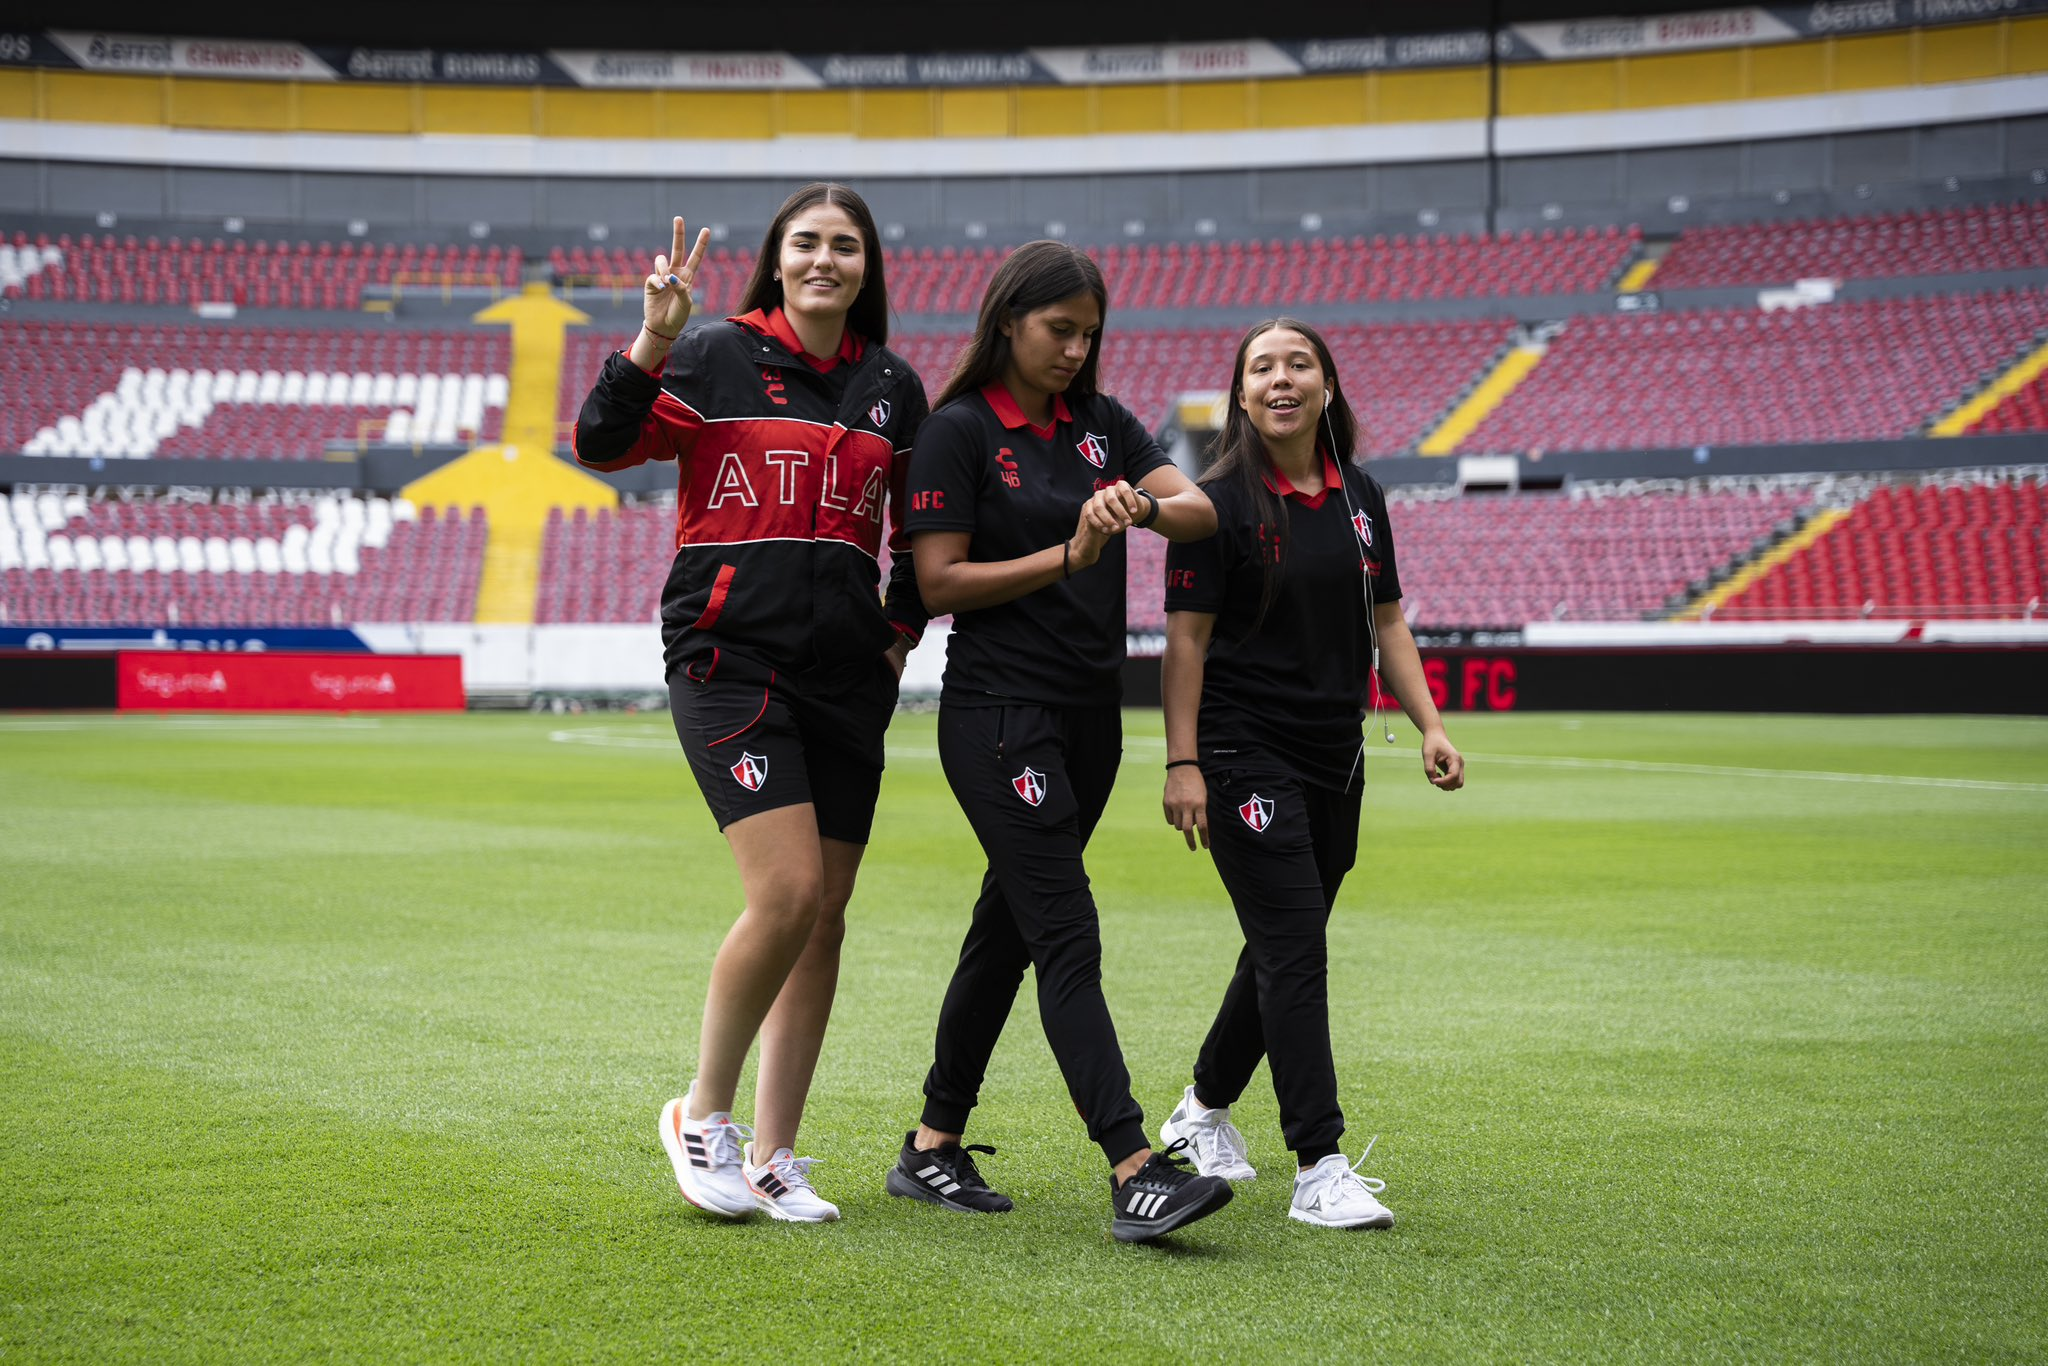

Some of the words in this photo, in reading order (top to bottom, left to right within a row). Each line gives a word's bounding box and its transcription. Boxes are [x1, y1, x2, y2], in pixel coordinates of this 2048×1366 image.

[185, 41, 305, 71] CEMENTOS
[441, 51, 541, 80] BOMBAS
[1001, 470, 1022, 489] 46
[911, 490, 945, 511] AFC
[1462, 657, 1517, 711] FC
